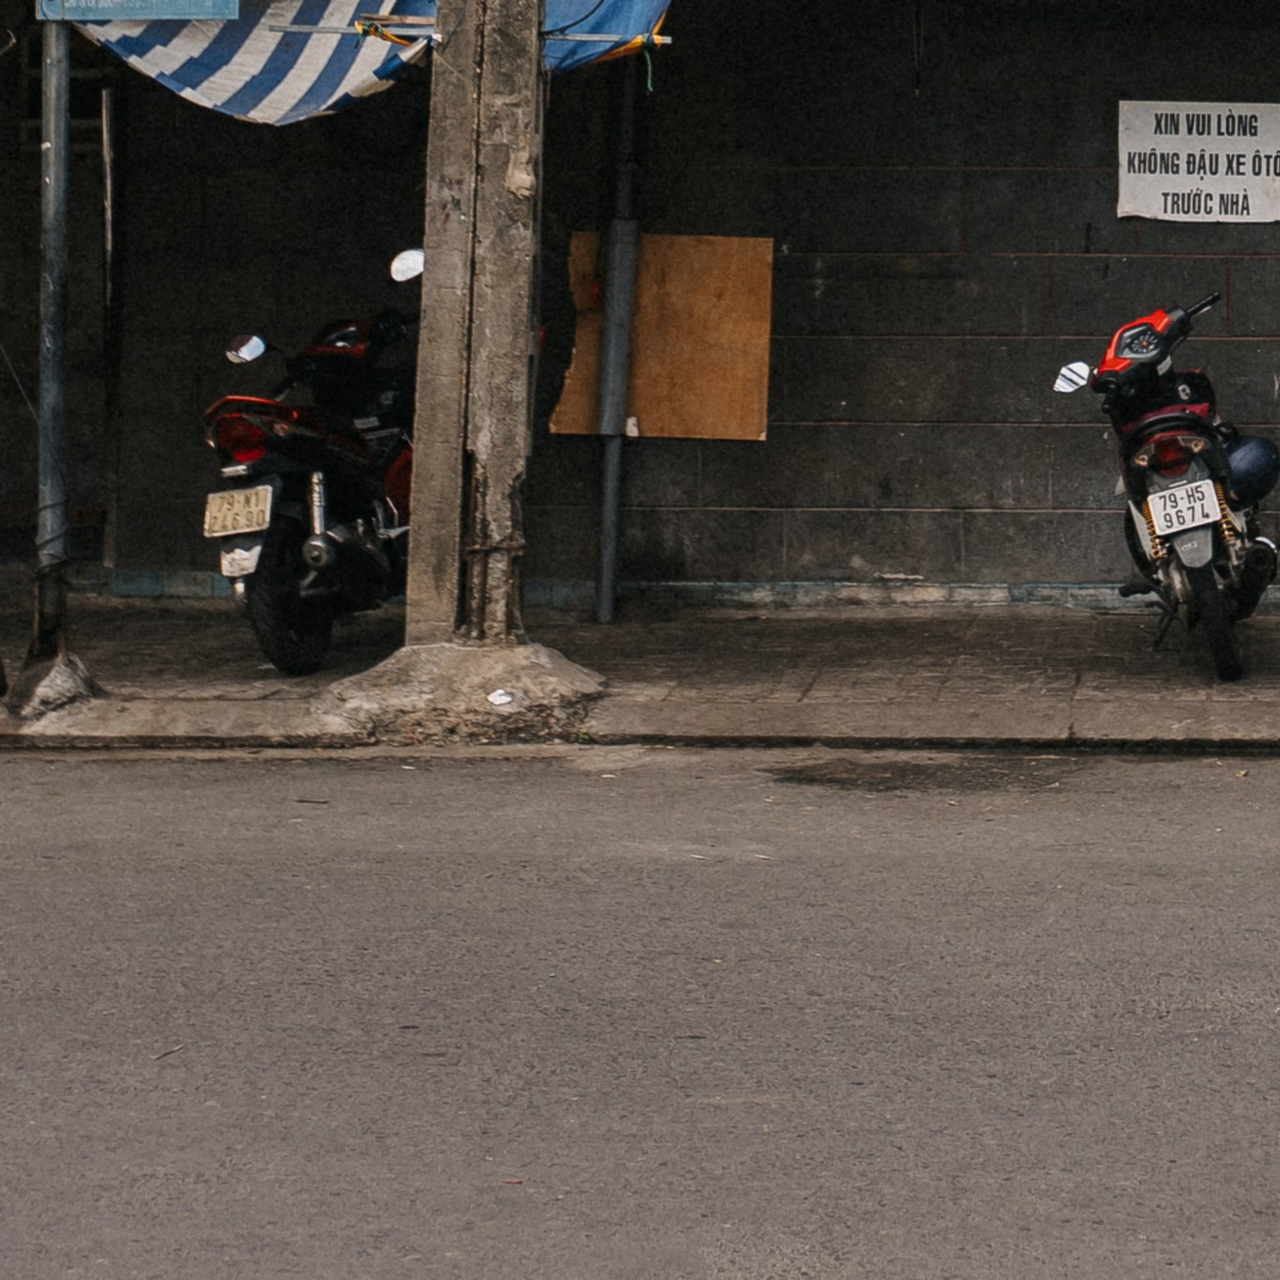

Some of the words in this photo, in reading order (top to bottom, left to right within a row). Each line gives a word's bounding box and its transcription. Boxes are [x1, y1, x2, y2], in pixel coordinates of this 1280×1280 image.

[1153, 113, 1180, 136] XIN
[1186, 113, 1212, 136] VUI
[1216, 109, 1258, 137] LÒNG
[1127, 148, 1180, 175] KHÔNG
[1186, 149, 1220, 181] ĐẬU
[1225, 153, 1247, 176] XE
[1161, 188, 1214, 215] TRƯỚC
[1219, 188, 1251, 216] NHÀ
[1159, 485, 1206, 511] 79-H5
[1164, 503, 1211, 529] 9674
